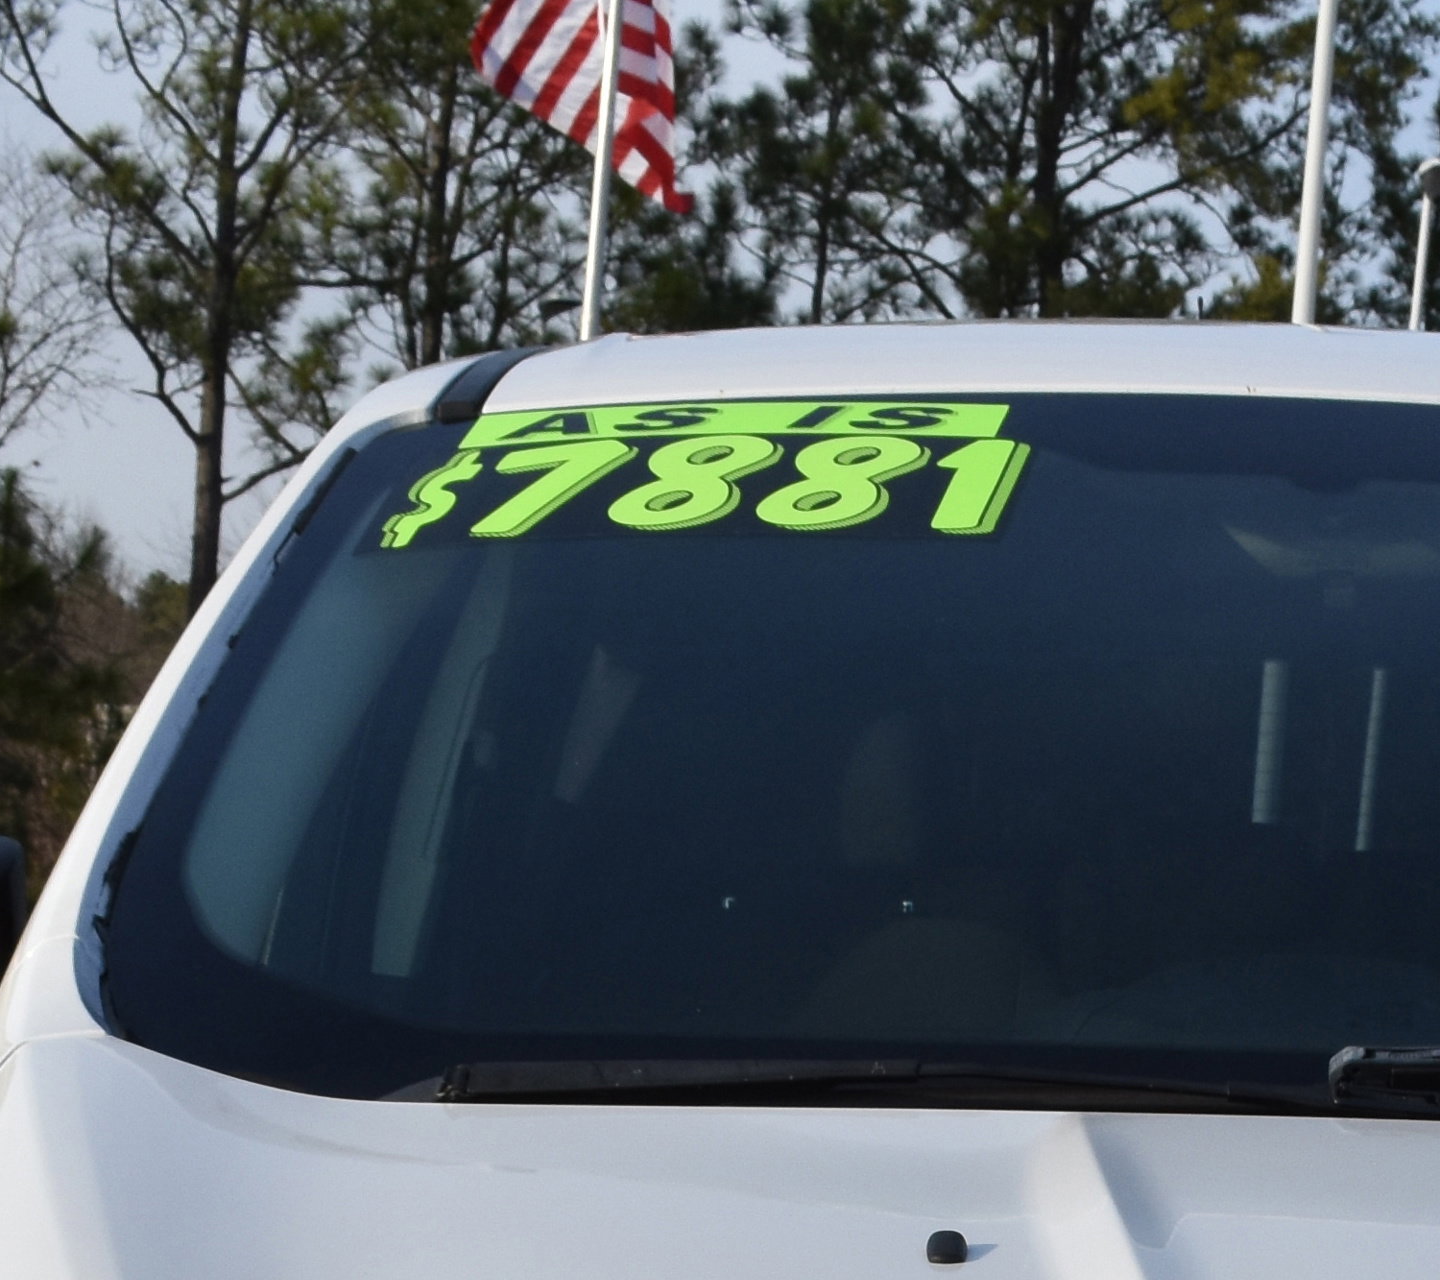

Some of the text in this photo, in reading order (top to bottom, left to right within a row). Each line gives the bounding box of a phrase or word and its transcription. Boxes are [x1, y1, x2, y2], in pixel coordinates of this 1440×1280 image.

[495, 405, 959, 442] AS IS
[380, 436, 1031, 548] $7881
